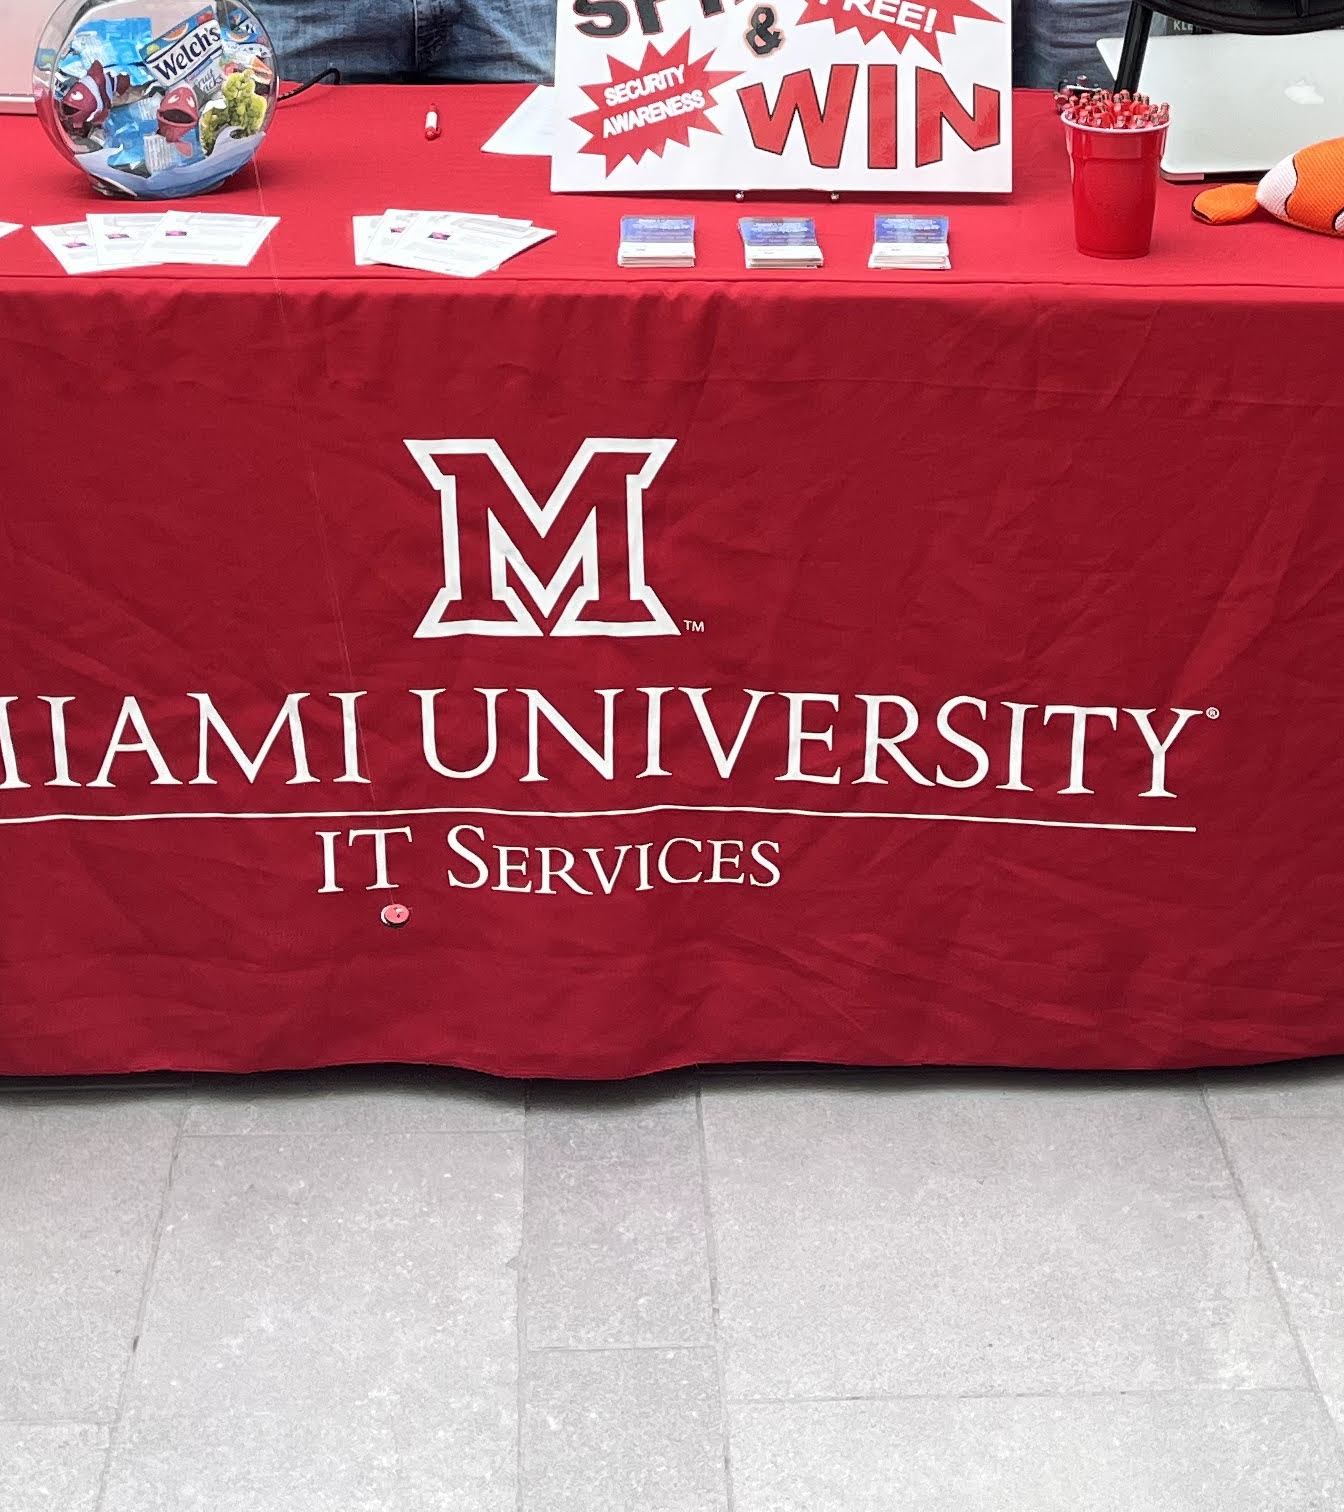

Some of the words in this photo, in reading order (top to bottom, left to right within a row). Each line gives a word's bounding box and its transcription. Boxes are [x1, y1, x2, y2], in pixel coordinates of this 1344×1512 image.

[153, 26, 220, 80] Welch's
[743, 5, 786, 58] &
[604, 64, 685, 108] SECURITY
[602, 90, 706, 139] AWARENESS
[736, 64, 1000, 170] WIN
[314, 824, 412, 896] IT
